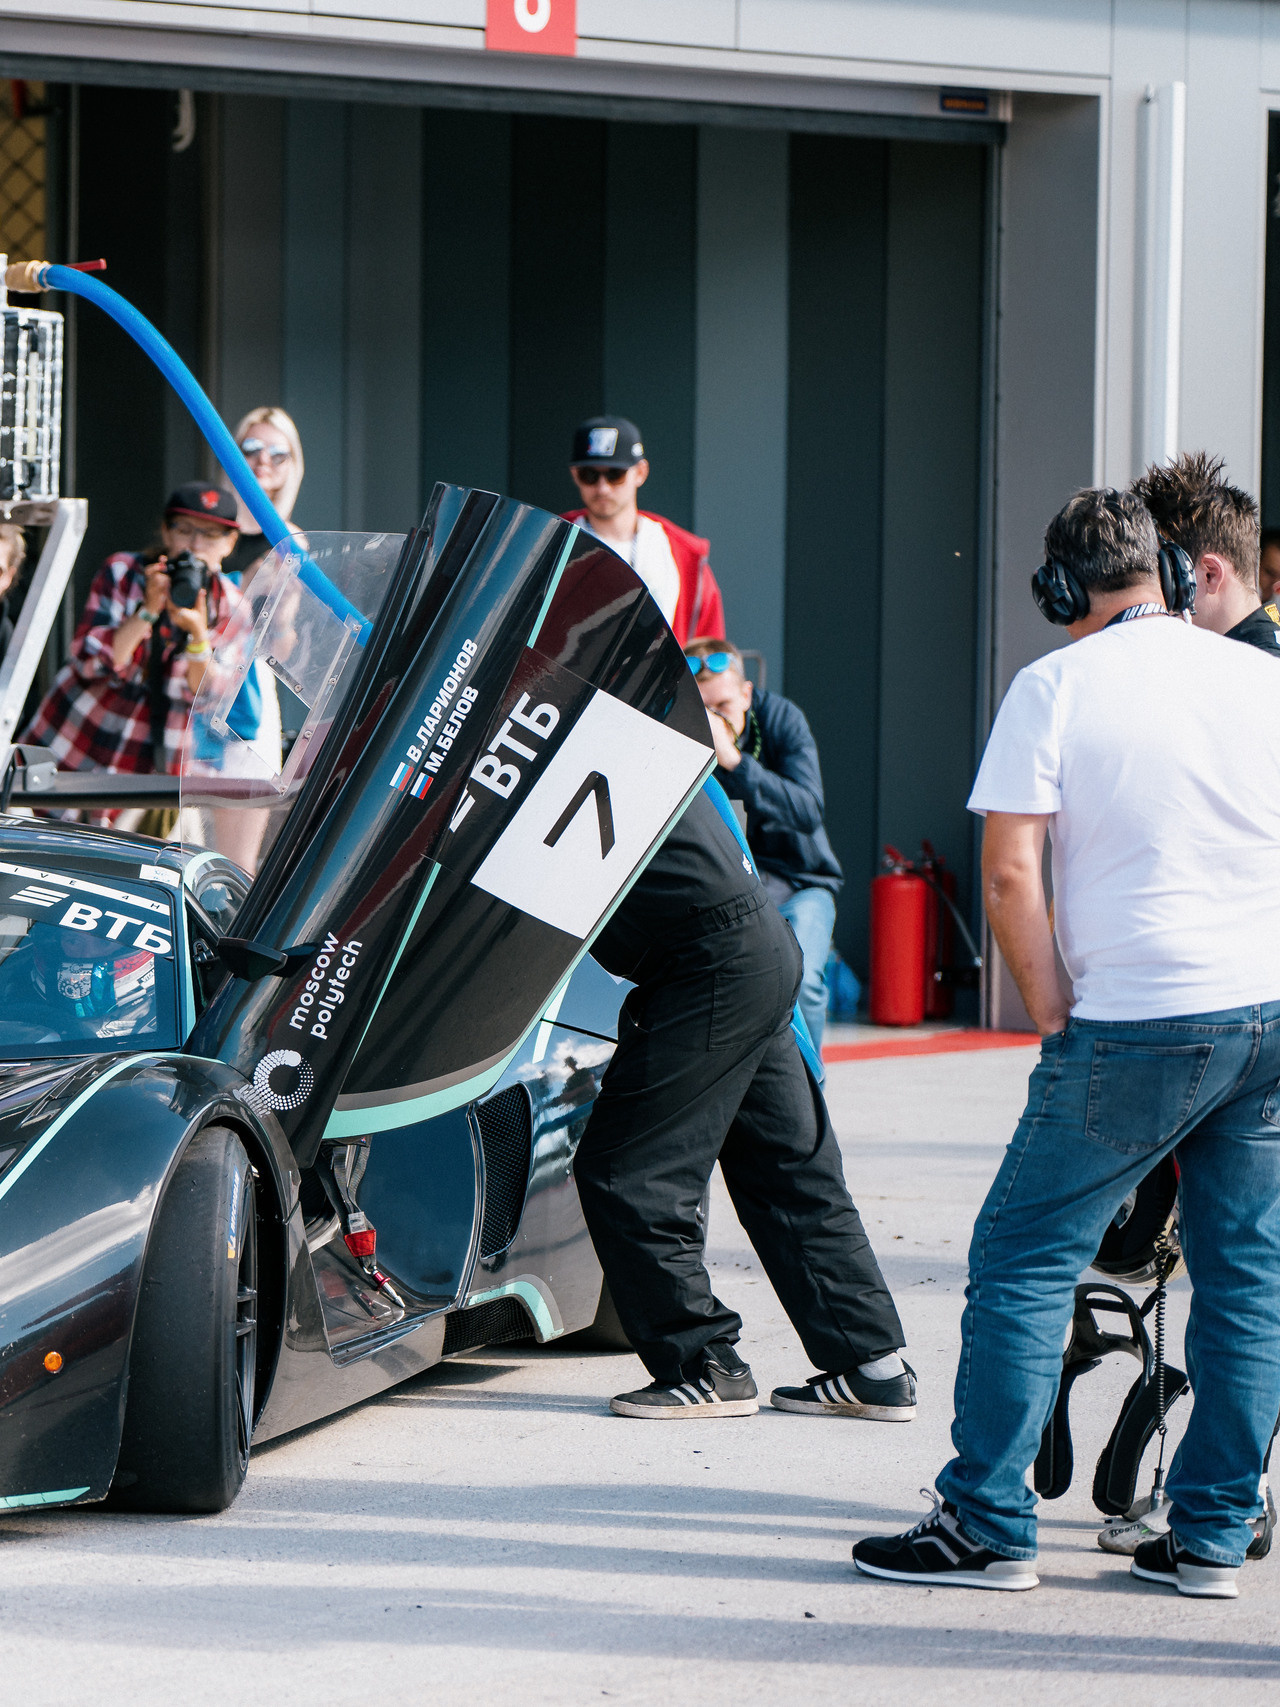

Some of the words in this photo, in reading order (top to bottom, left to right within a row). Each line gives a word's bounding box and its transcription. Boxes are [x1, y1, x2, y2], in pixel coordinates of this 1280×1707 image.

[406, 638, 478, 764] В.ЛАРИОНОВ
[424, 685, 479, 774] М.БЕЛОВ
[470, 691, 561, 800] ВТБ
[543, 770, 616, 861] 7
[58, 901, 172, 955] ВТБ
[289, 931, 340, 1030] moscow
[310, 939, 363, 1041] polytech
